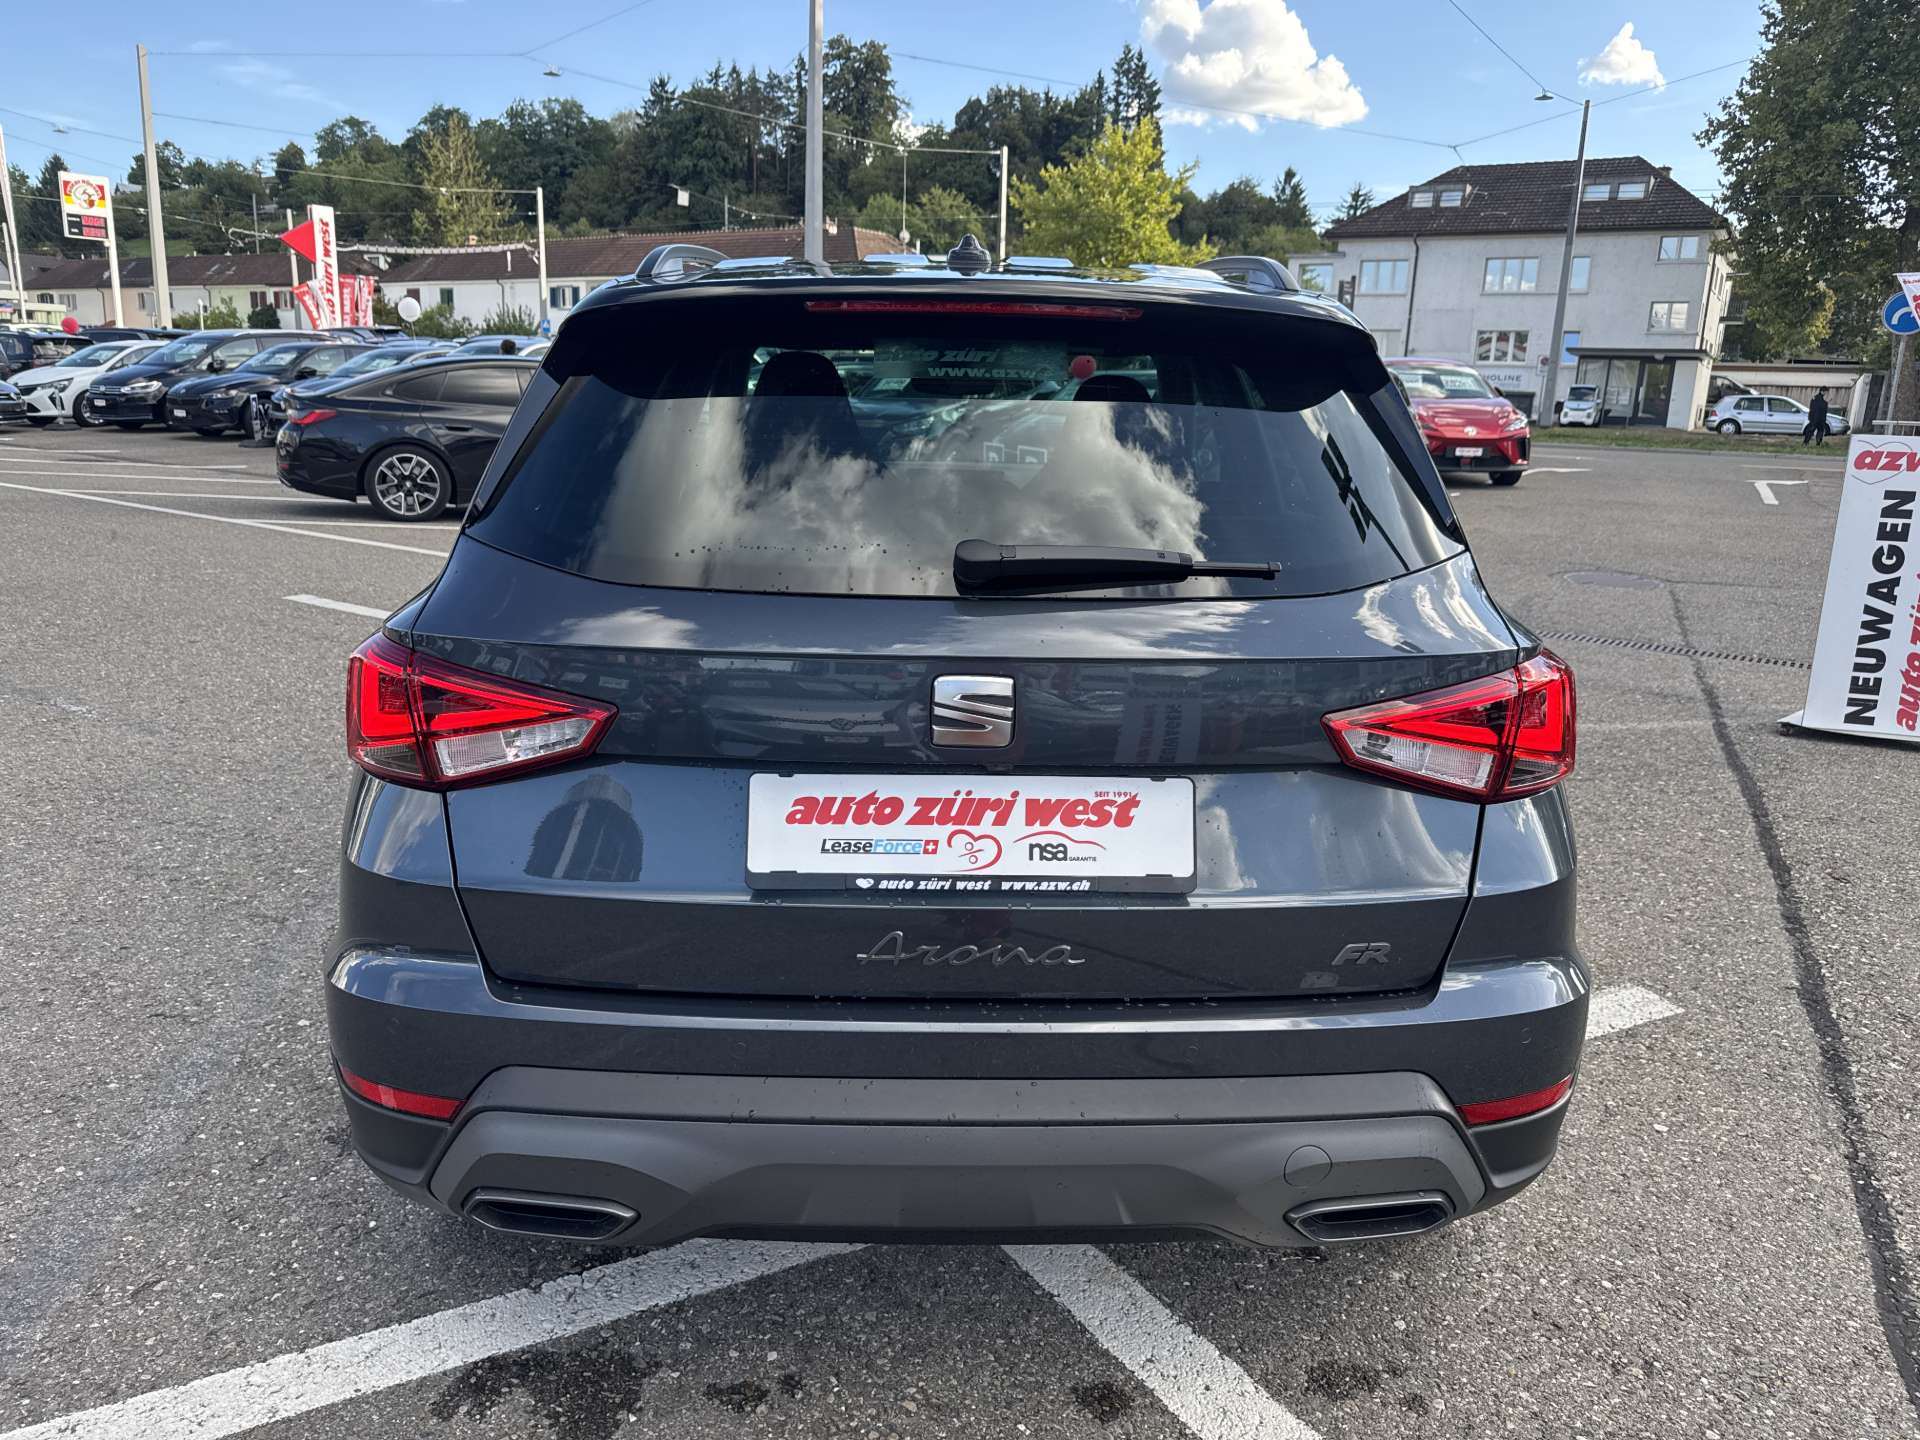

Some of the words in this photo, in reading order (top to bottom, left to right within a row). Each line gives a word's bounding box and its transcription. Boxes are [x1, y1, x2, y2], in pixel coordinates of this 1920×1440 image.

[1843, 489, 1917, 726] NEUWAGEN
[1094, 790, 1110, 798] SEIT
[1112, 790, 1133, 798] 1991
[785, 789, 904, 825] auto
[909, 790, 1020, 827] züri
[1024, 792, 1141, 828] west
[820, 838, 922, 855] LeaseForce
[1029, 843, 1068, 862] nsa
[878, 878, 914, 890] auto
[916, 878, 952, 891] züri
[955, 878, 991, 891] west
[1001, 879, 1091, 892] www.azw.ch
[856, 930, 1087, 968] Arona
[1331, 941, 1393, 967] FR
